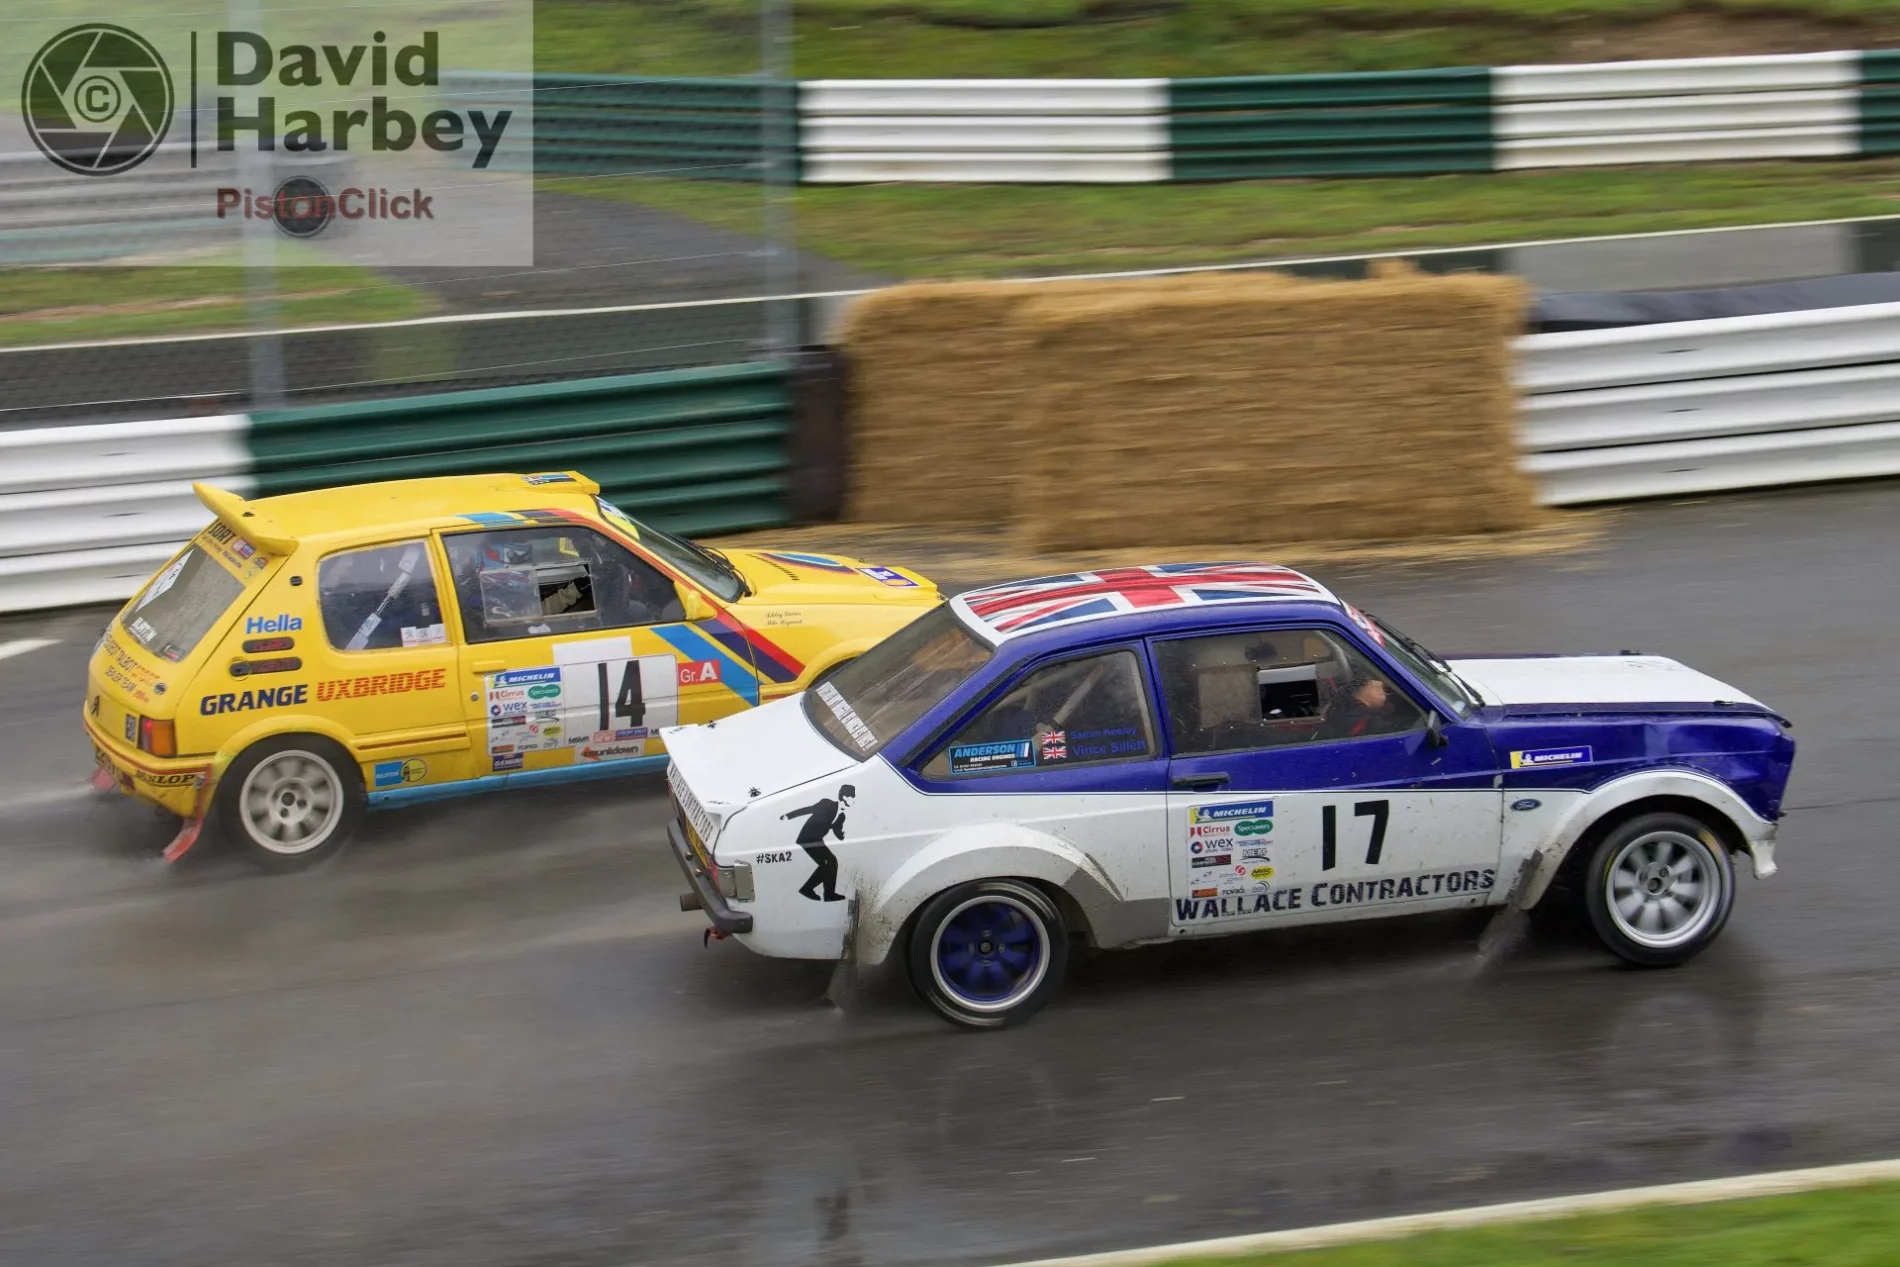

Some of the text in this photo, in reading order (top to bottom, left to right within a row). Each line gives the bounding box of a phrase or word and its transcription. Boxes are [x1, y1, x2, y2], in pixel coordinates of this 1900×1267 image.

[245, 613, 302, 634] Hella
[508, 672, 555, 683] MICHELIN
[199, 668, 447, 716] GRANGE UXBRIDGE
[500, 690, 525, 698] Cirrus
[597, 659, 646, 731] 14
[503, 701, 528, 712] wex
[954, 743, 1016, 758] ANDERSON
[1072, 744, 1107, 757] Vince
[1534, 752, 1583, 762] MICHELIN
[135, 769, 196, 785] NLOP
[1213, 806, 1267, 817] MICHELIN
[1203, 825, 1230, 834] Cirrus
[1321, 799, 1389, 871] 17
[1205, 838, 1234, 849] wex
[756, 851, 793, 864] #SKA2
[1175, 869, 1496, 921] WALLACE CONTRACTORS
